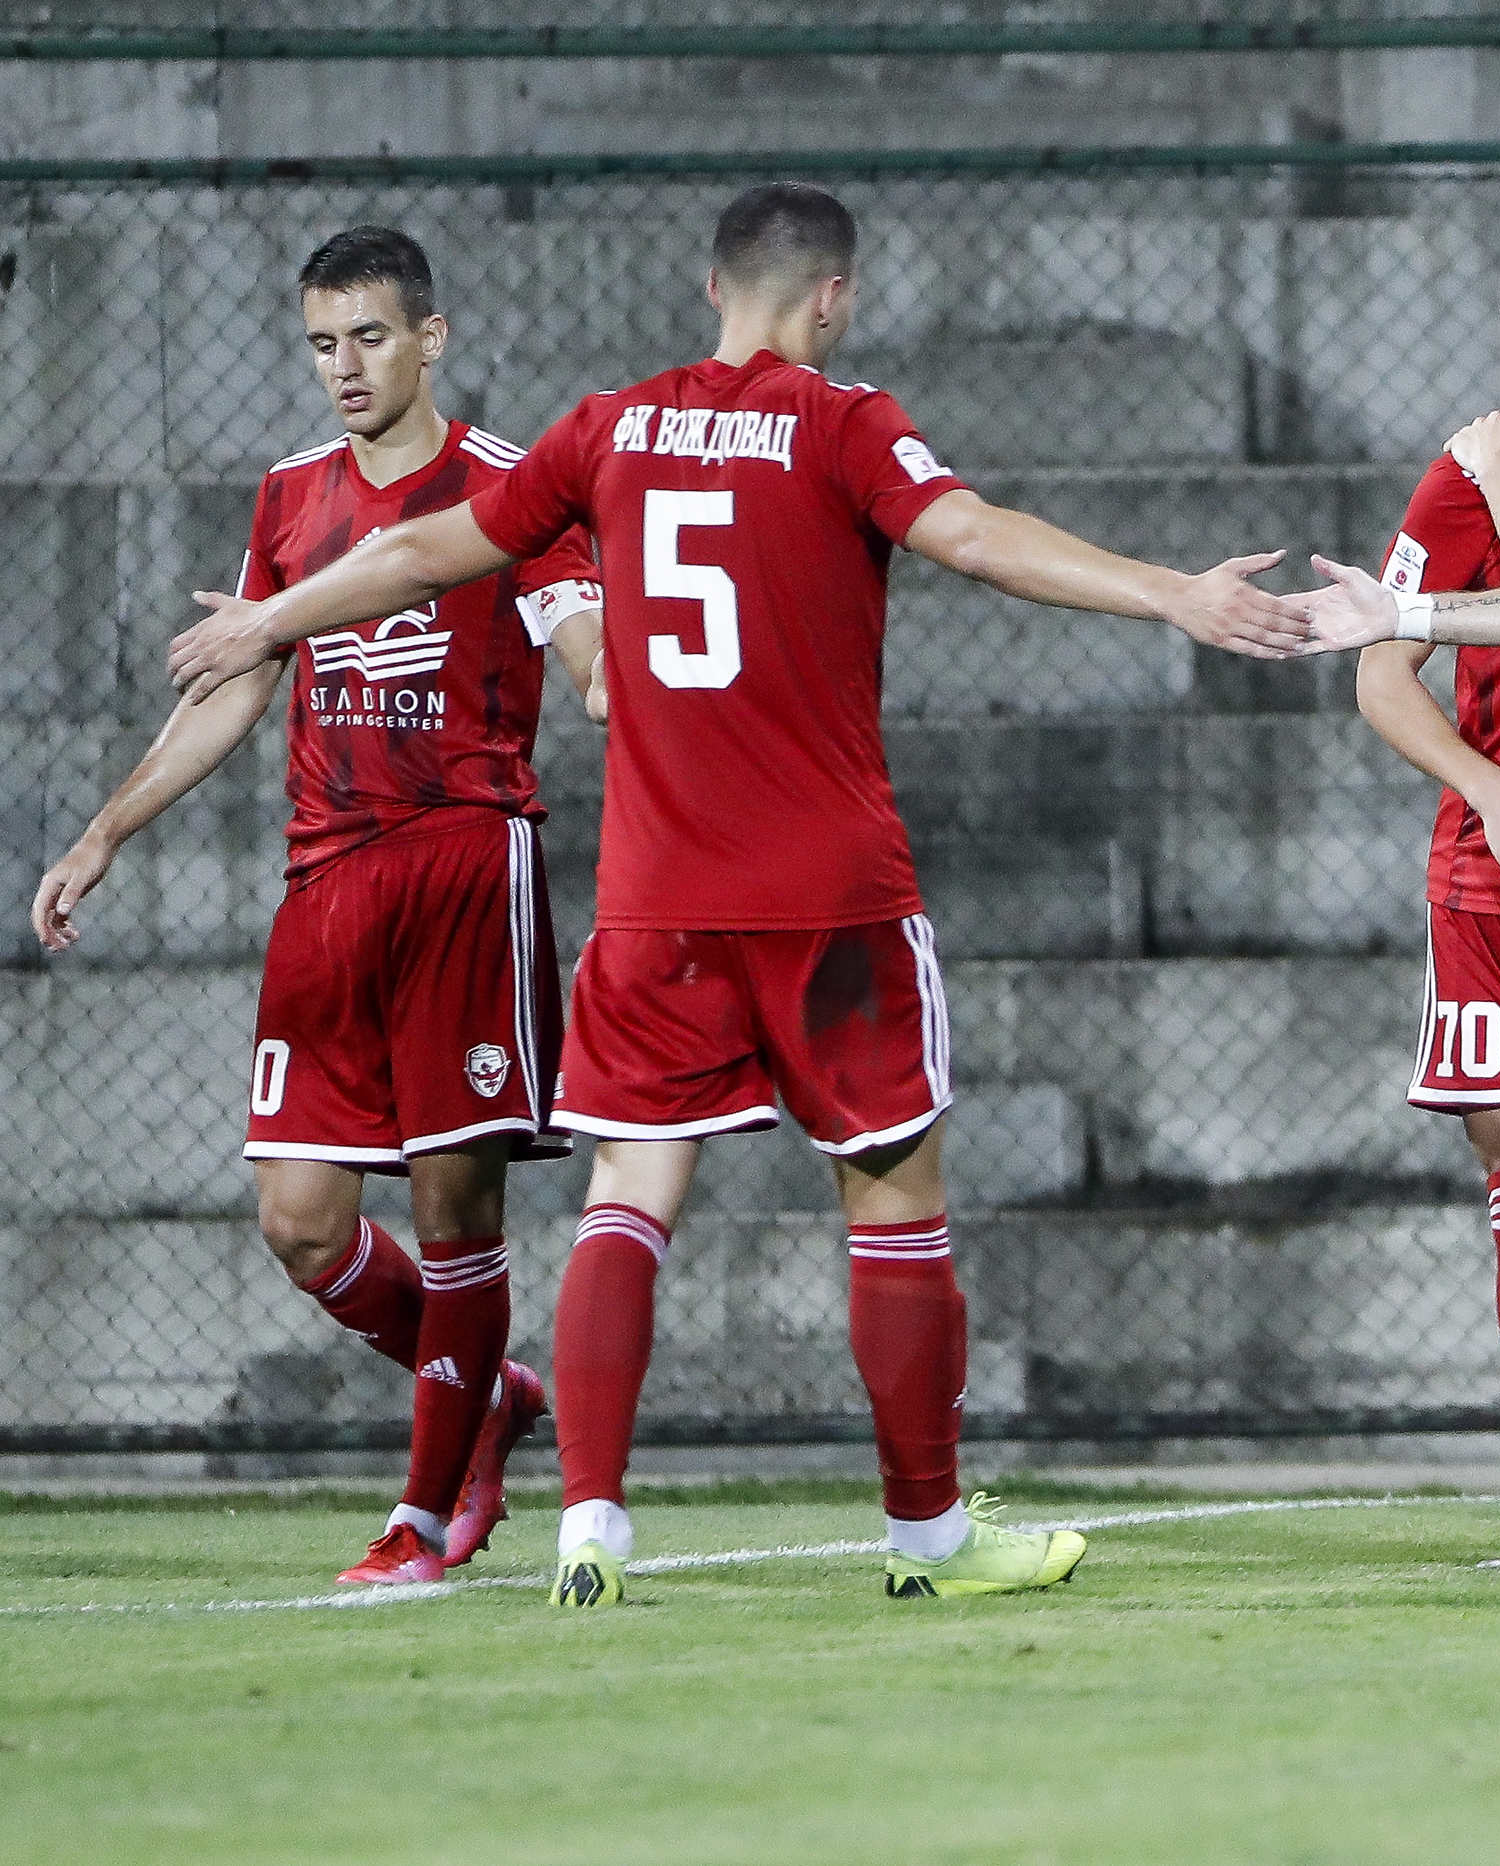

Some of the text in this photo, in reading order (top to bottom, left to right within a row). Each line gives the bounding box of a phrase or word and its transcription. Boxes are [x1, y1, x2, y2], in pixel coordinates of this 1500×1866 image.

[612, 404, 799, 472] ФК ВОЖДОВАЦ
[643, 489, 743, 689] 5
[310, 687, 446, 714] STADION
[375, 715, 444, 730] CENTER
[251, 1038, 291, 1116] 0
